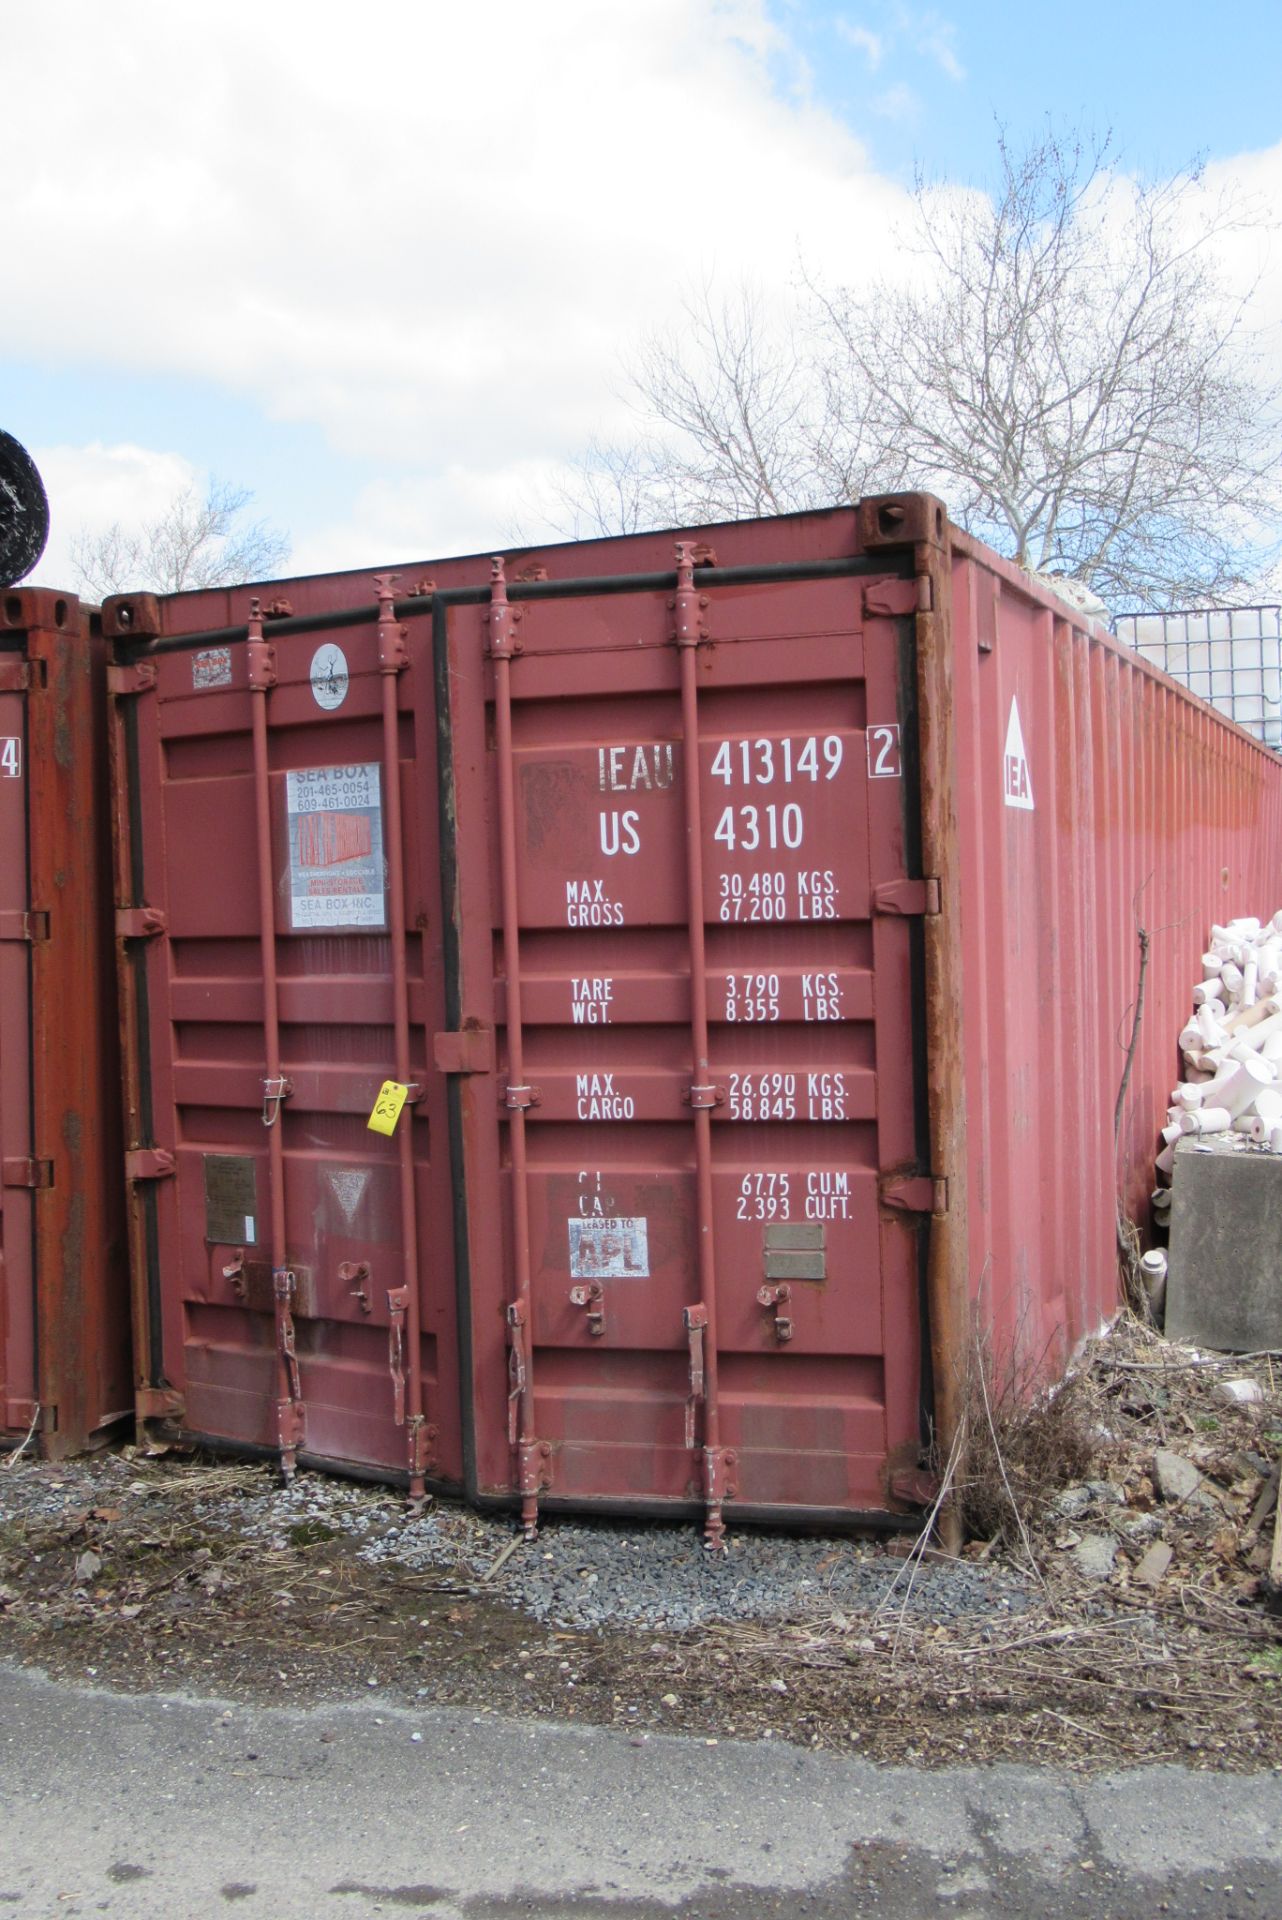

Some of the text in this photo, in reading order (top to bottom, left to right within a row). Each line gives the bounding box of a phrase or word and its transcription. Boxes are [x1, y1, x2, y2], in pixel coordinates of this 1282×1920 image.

[1, 740, 18, 776] 4
[598, 728, 895, 791] IEAU 413149 2
[296, 765, 369, 784] SEA BOX
[1006, 754, 1029, 799] IEA
[297, 781, 370, 799] 201-465-0054
[297, 795, 370, 811] 609-461-0024
[599, 803, 804, 856] US 4310
[566, 871, 840, 903] MAX. 30,480 KGS.
[300, 896, 376, 910] SEA BOX INC.
[567, 895, 840, 927] GROSS 67,200 LBS.
[571, 973, 844, 1001] TARE 3,790 KGS.
[572, 1002, 612, 1024] WGT.
[804, 998, 845, 1021] LBS.
[576, 1073, 849, 1098] MAX. 26,690 KGS.
[376, 1100, 397, 1119] 63
[577, 1097, 635, 1120] CARGO
[809, 1098, 850, 1121] LBS.
[741, 1173, 790, 1196] 67.75
[737, 1196, 790, 1220] 2,393
[582, 1219, 634, 1230] LEASED TO
[577, 1233, 643, 1271] APL
